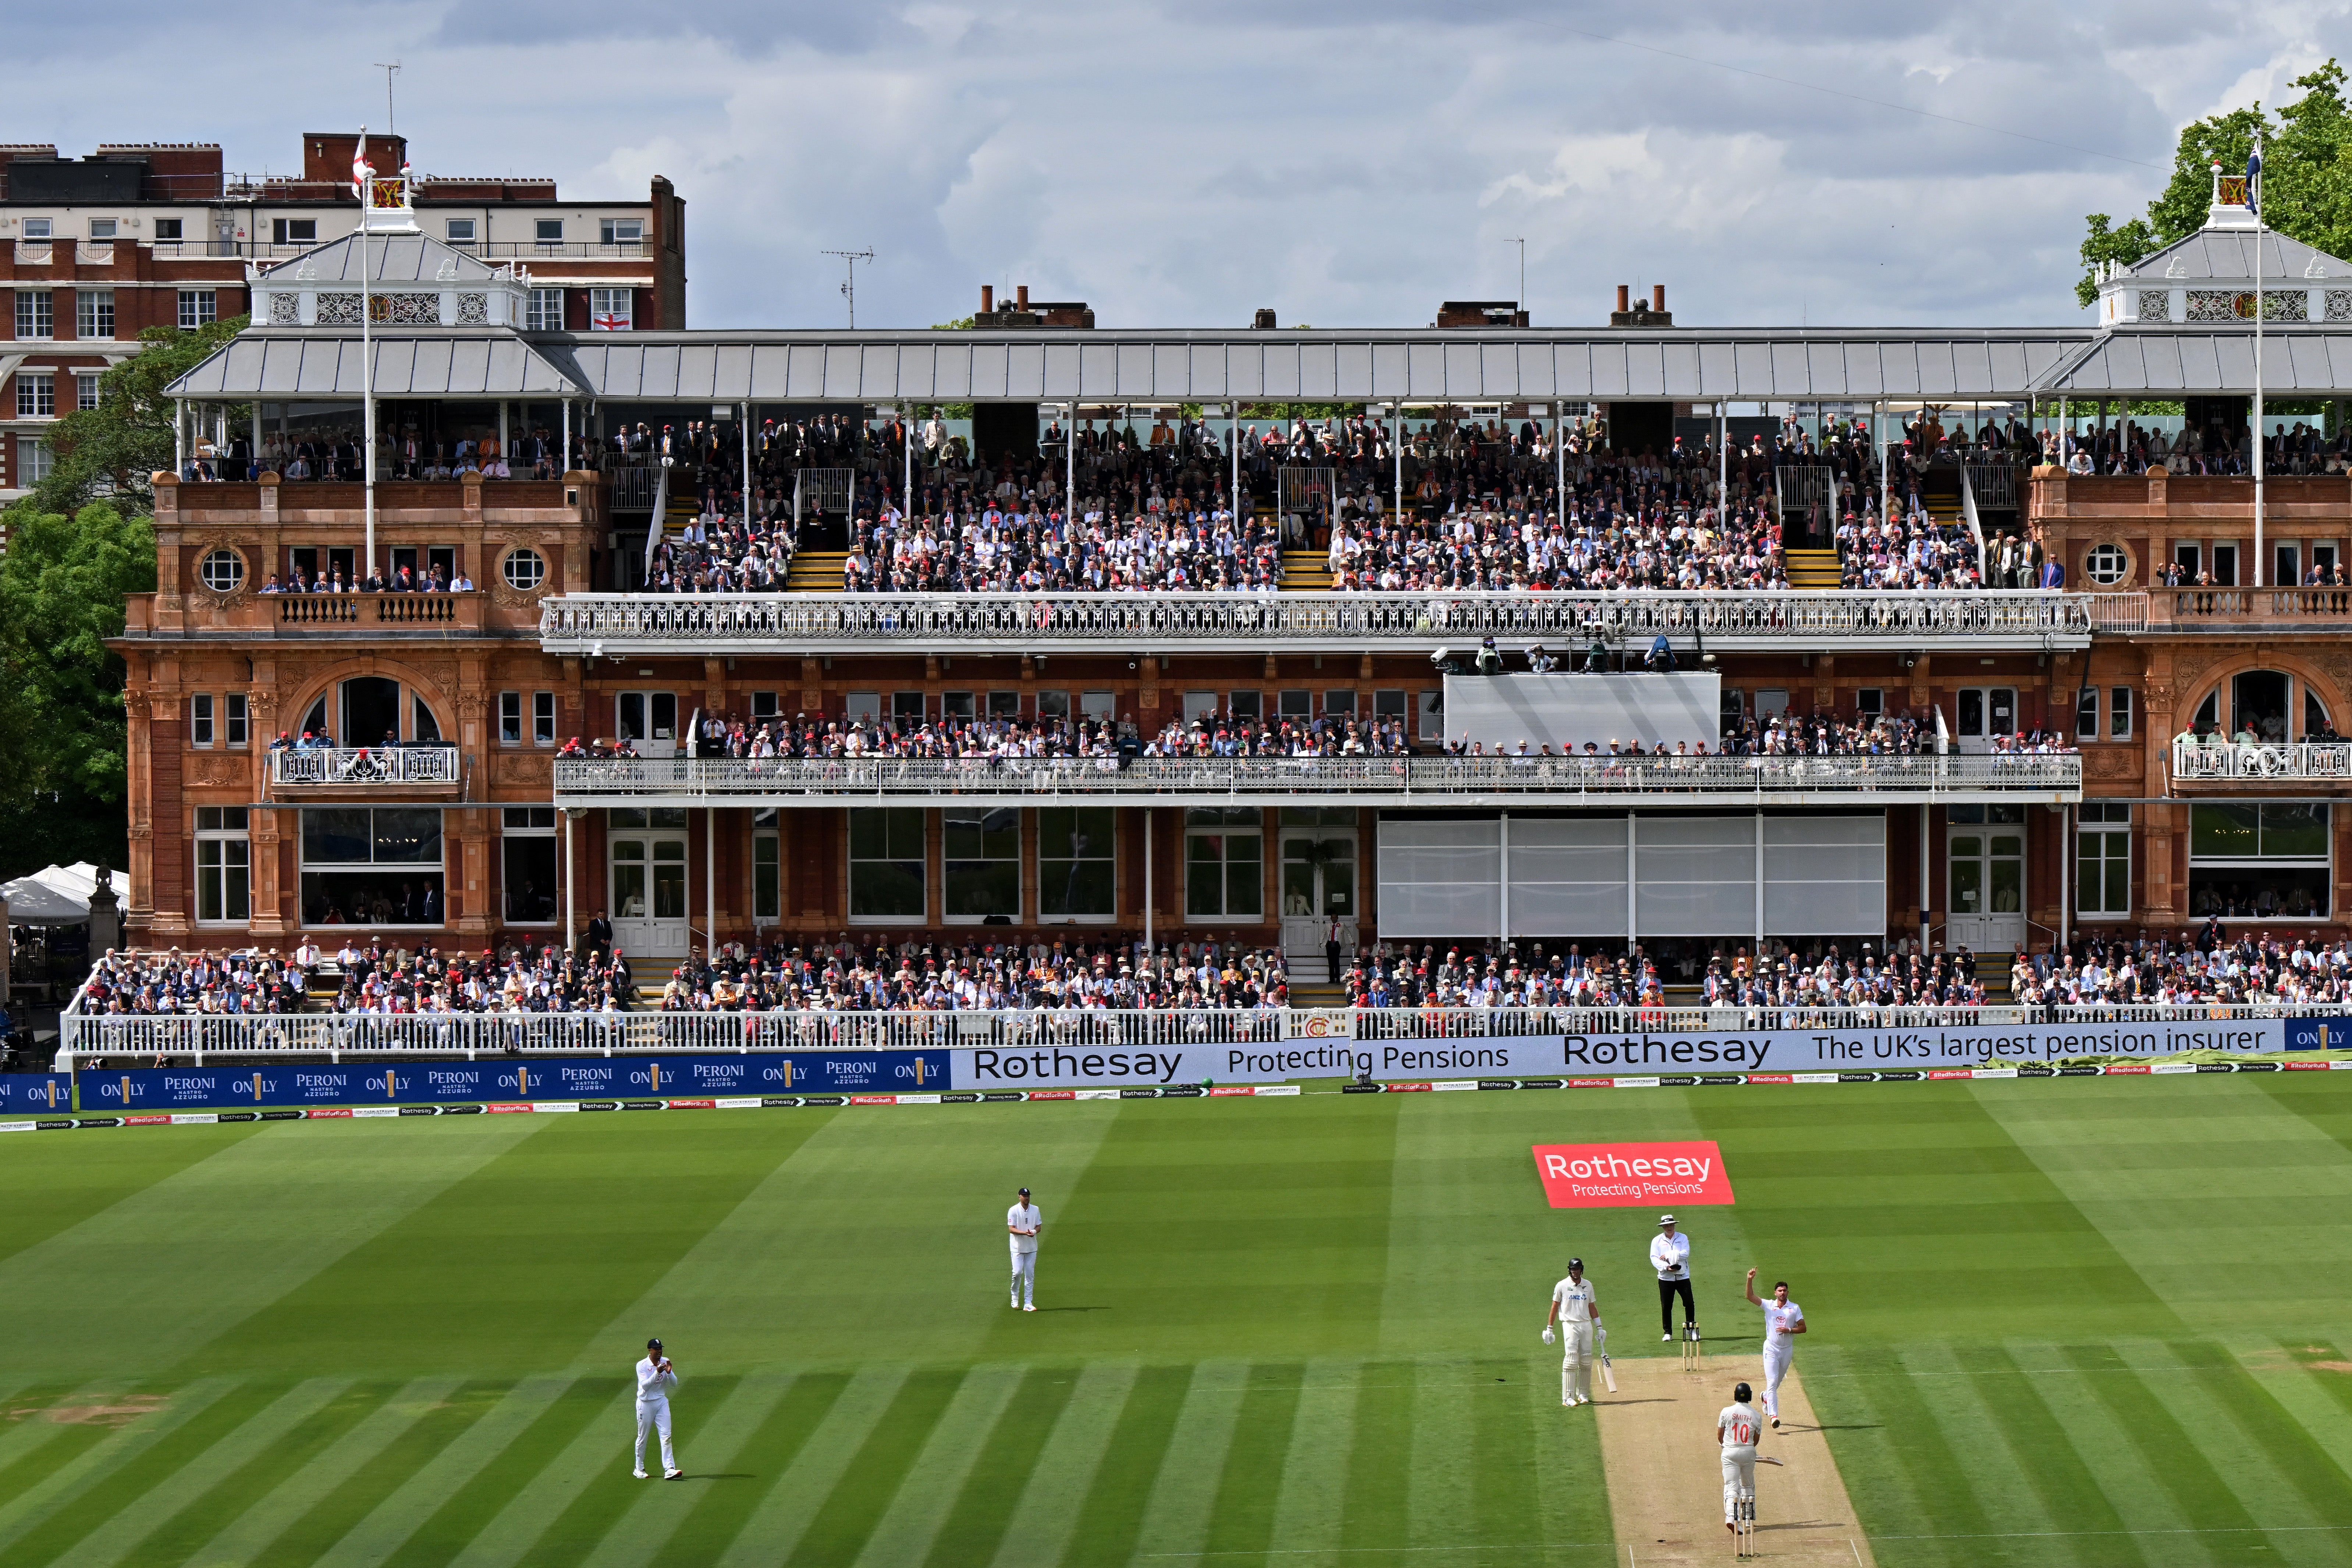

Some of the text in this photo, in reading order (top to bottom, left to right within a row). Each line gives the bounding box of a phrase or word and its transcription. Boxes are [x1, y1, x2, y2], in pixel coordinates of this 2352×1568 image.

[1564, 1035, 1771, 1069] Rothesay
[1812, 1028, 2266, 1062] The UK's largest pension insurer
[975, 1049, 1182, 1083] Rothesay
[1229, 1044, 1508, 1075] Protecting Pensions
[562, 1068, 612, 1080] PERONI
[694, 1065, 743, 1077] PERONI
[826, 1062, 876, 1073] PERONI
[165, 1077, 215, 1089] PERONI
[296, 1074, 346, 1086] PERONI
[429, 1071, 479, 1083] PERONI
[1545, 1153, 1710, 1182] Rothesay
[1571, 1181, 1703, 1198] Protecting Pensions
[1732, 1414, 1752, 1422] SMITH
[1731, 1422, 1749, 1444] 10
